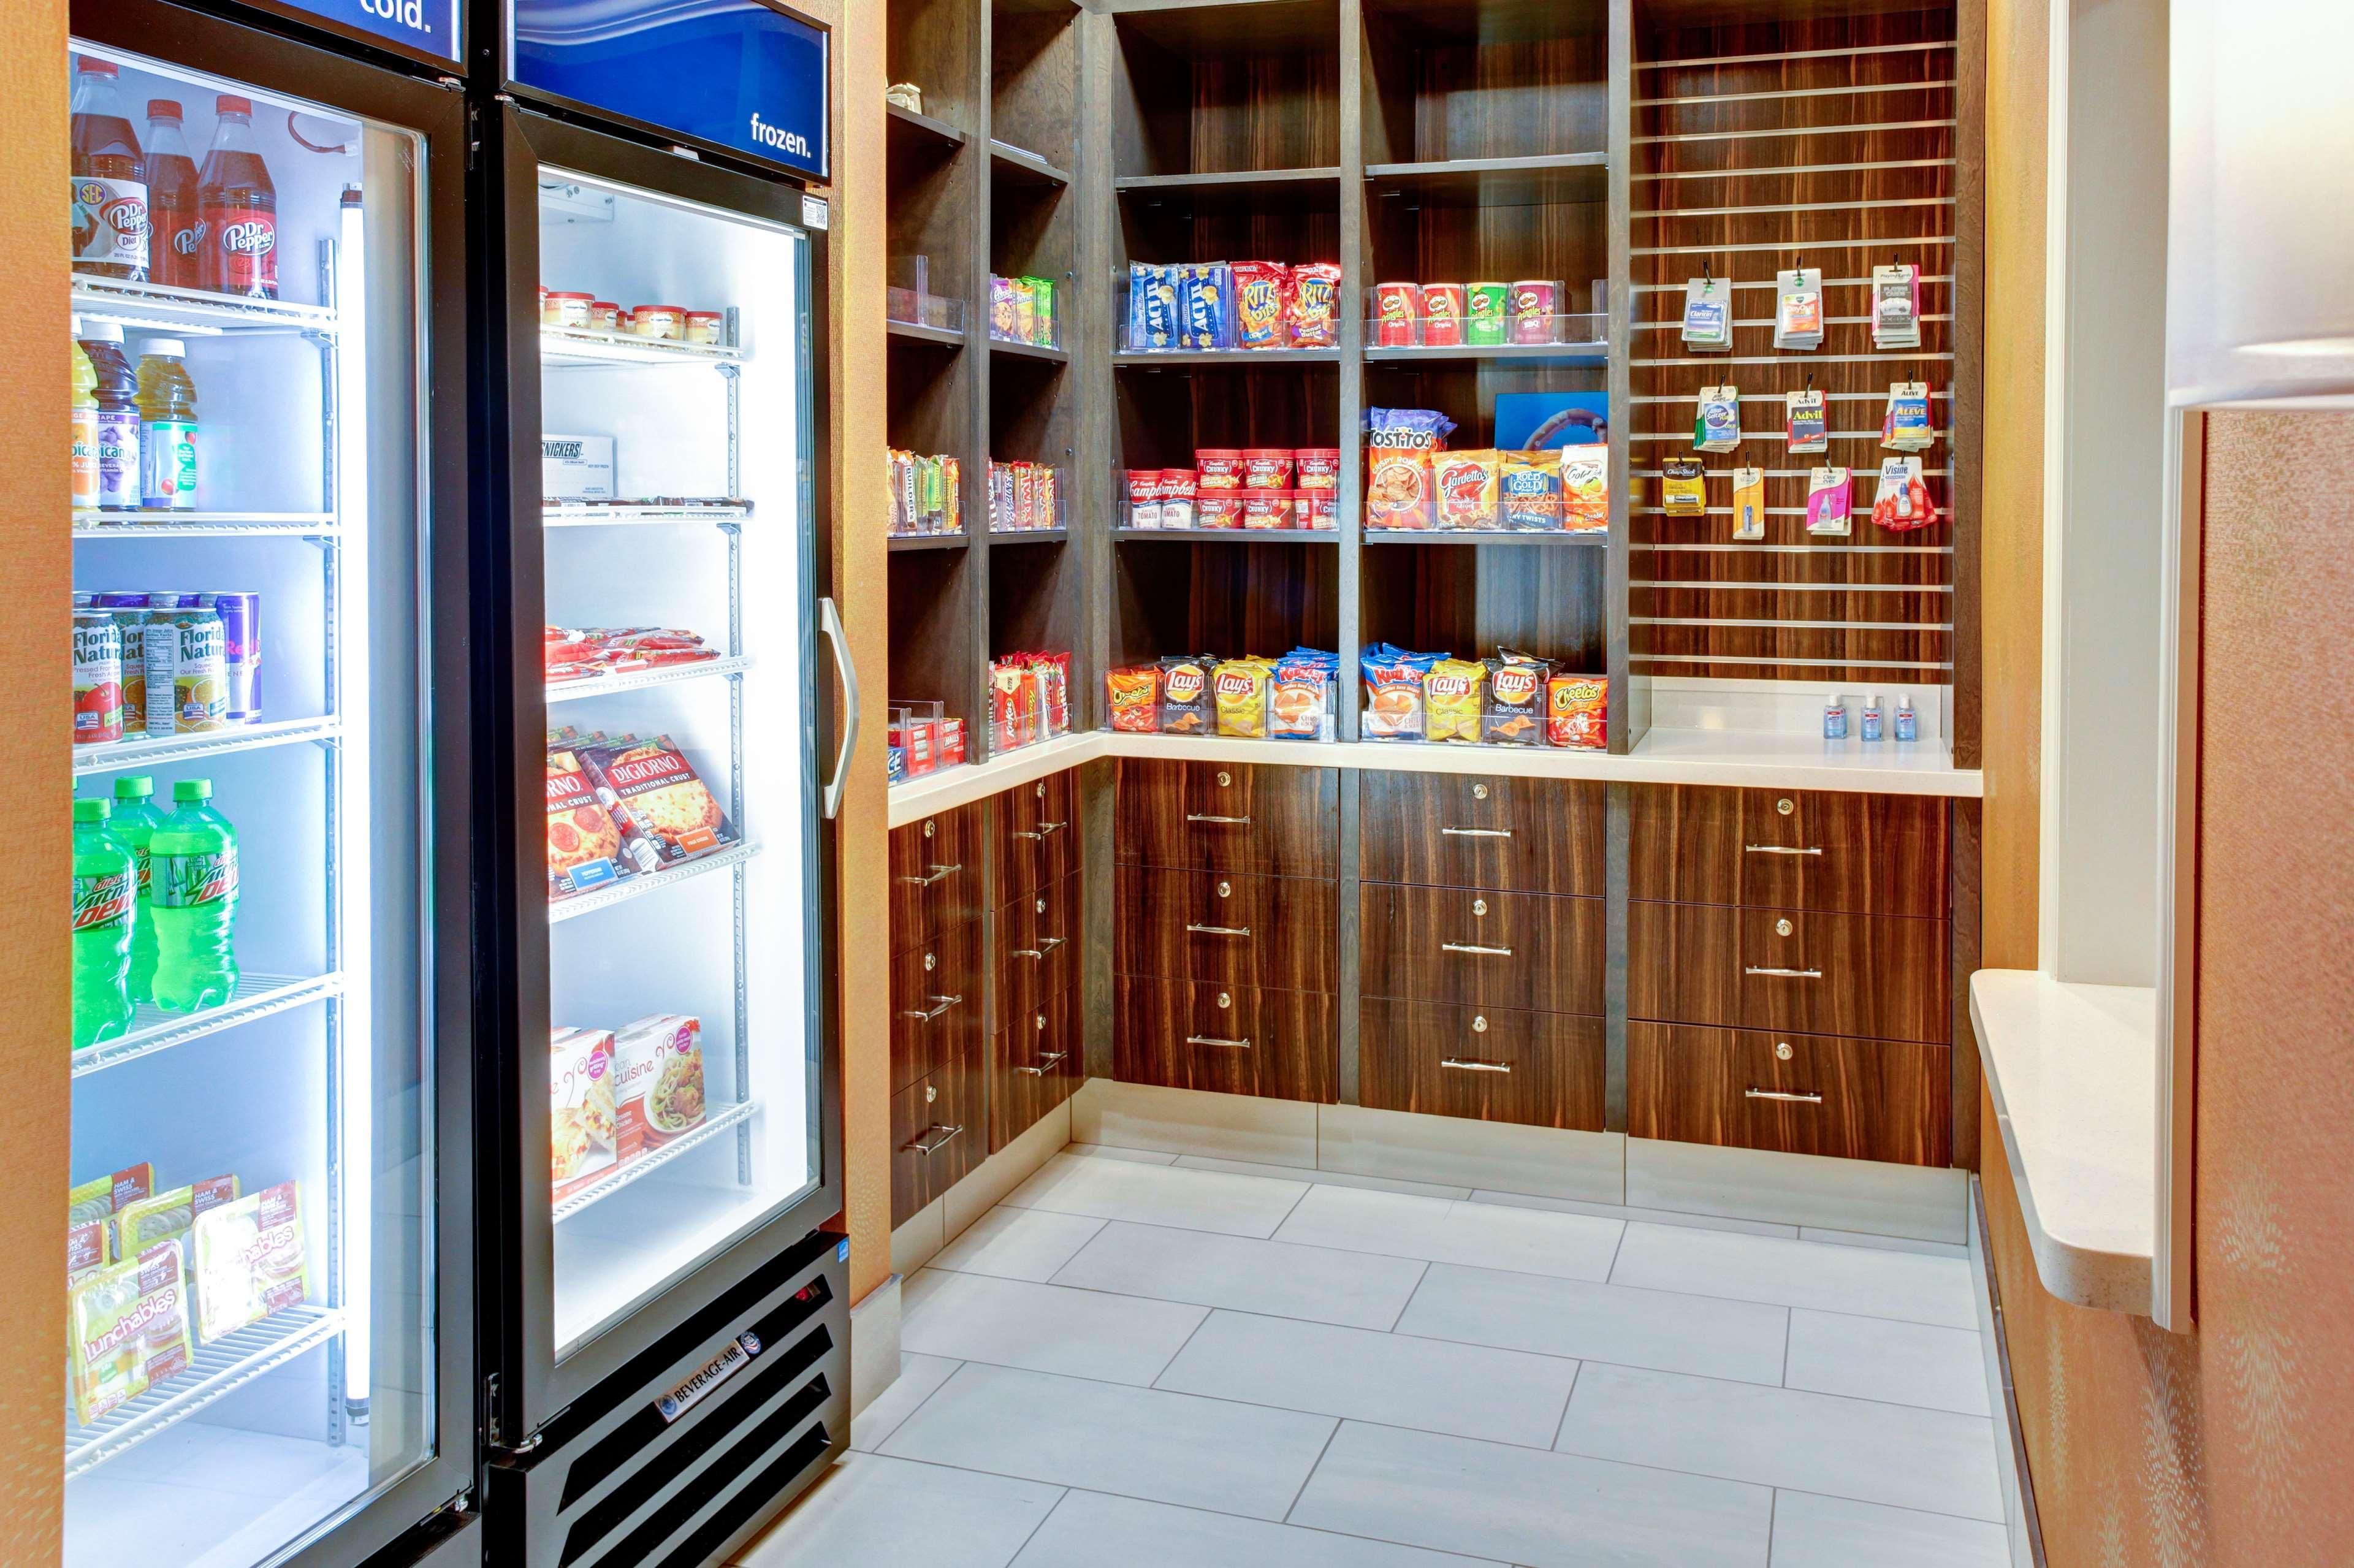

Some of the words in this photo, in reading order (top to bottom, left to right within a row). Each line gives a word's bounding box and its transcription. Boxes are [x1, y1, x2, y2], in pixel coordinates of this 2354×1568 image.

[359, 0, 432, 33] cold.
[751, 113, 812, 158] frozen.
[80, 184, 104, 204] SEC
[129, 203, 144, 215] Dr
[110, 204, 148, 234] Pepper
[249, 221, 264, 235] Dr
[224, 224, 273, 254] Pepper
[1146, 281, 1160, 299] II
[1190, 282, 1203, 300] II
[1244, 283, 1276, 308] RITZ
[1301, 281, 1333, 308] RITZ
[1148, 299, 1164, 330] ACT
[1192, 300, 1209, 331] ACT
[1382, 309, 1404, 326] Pringles
[1517, 306, 1541, 324] Pringles
[1793, 410, 1823, 421] Advil
[1373, 456, 1394, 474] CRISPY
[1397, 456, 1426, 477] ROUNDS
[1885, 465, 1908, 475] Visine
[1516, 471, 1541, 481] ROLD
[1512, 479, 1544, 492] GOLD
[1522, 514, 1547, 524] TWISTS
[1167, 671, 1202, 691] Lay's
[1217, 674, 1253, 694] Lay's
[1431, 676, 1470, 696] Lay's
[1495, 672, 1534, 693] Lay's
[1555, 684, 1599, 710] Cheetos
[1166, 702, 1200, 712] Barbecue
[1495, 703, 1534, 714] Barbecue
[621, 777, 669, 796] TRADITIONAL
[670, 772, 691, 783] CRUST
[568, 795, 593, 806] CRUST
[614, 1058, 631, 1071] ean
[614, 1060, 654, 1087] cuisine
[113, 1184, 134, 1195] SWISS
[114, 1179, 130, 1189] HAM
[195, 1189, 211, 1199] HAM
[195, 1195, 215, 1205] SWISS
[675, 1347, 741, 1404] BEVERAGE-AIR
